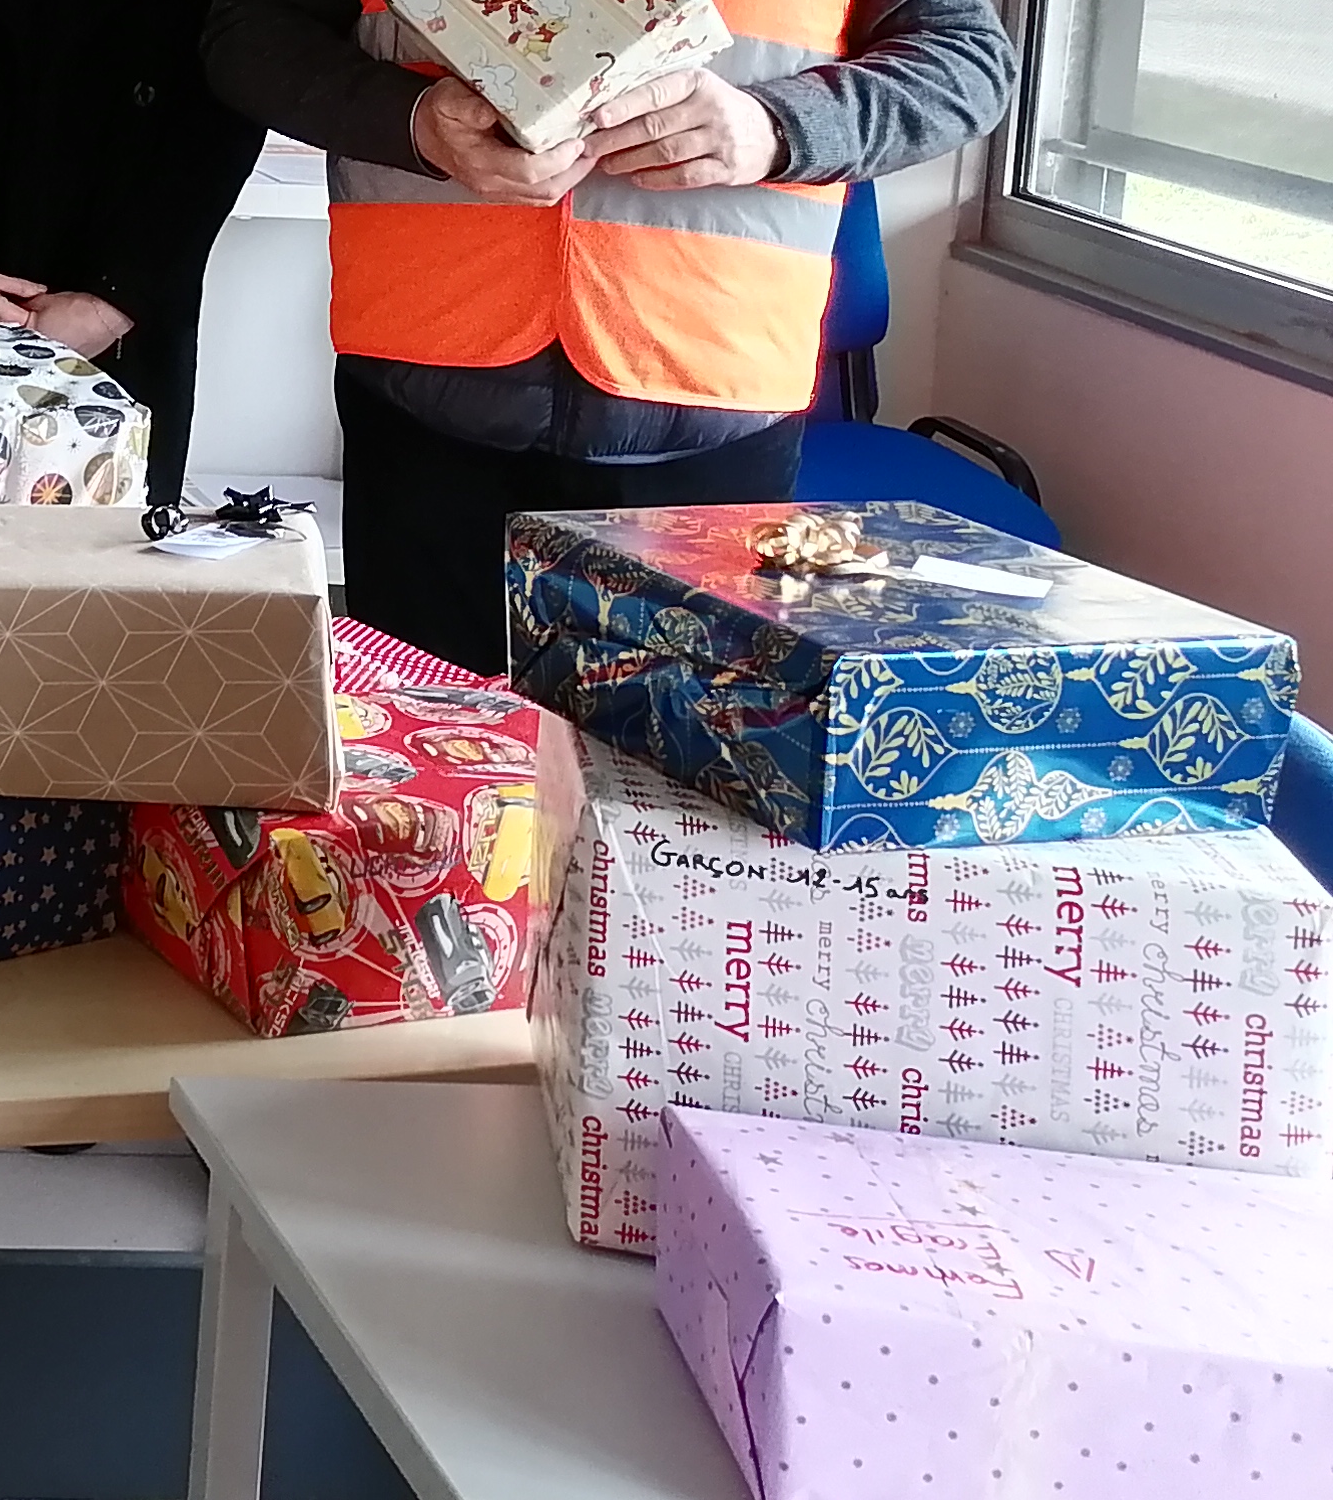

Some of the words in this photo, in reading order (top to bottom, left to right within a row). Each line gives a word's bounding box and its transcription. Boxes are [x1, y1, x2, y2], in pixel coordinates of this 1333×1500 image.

[588, 839, 616, 977] christmas
[651, 839, 768, 879] GARÇON
[714, 920, 753, 1043] merry
[813, 920, 833, 992] merry
[1043, 866, 1085, 988] merry
[1050, 997, 1074, 1124] CHRISTMAS
[1137, 942, 1185, 1138] christmas
[1239, 1013, 1274, 1160] christmas
[827, 1222, 1001, 1261] Fragile
